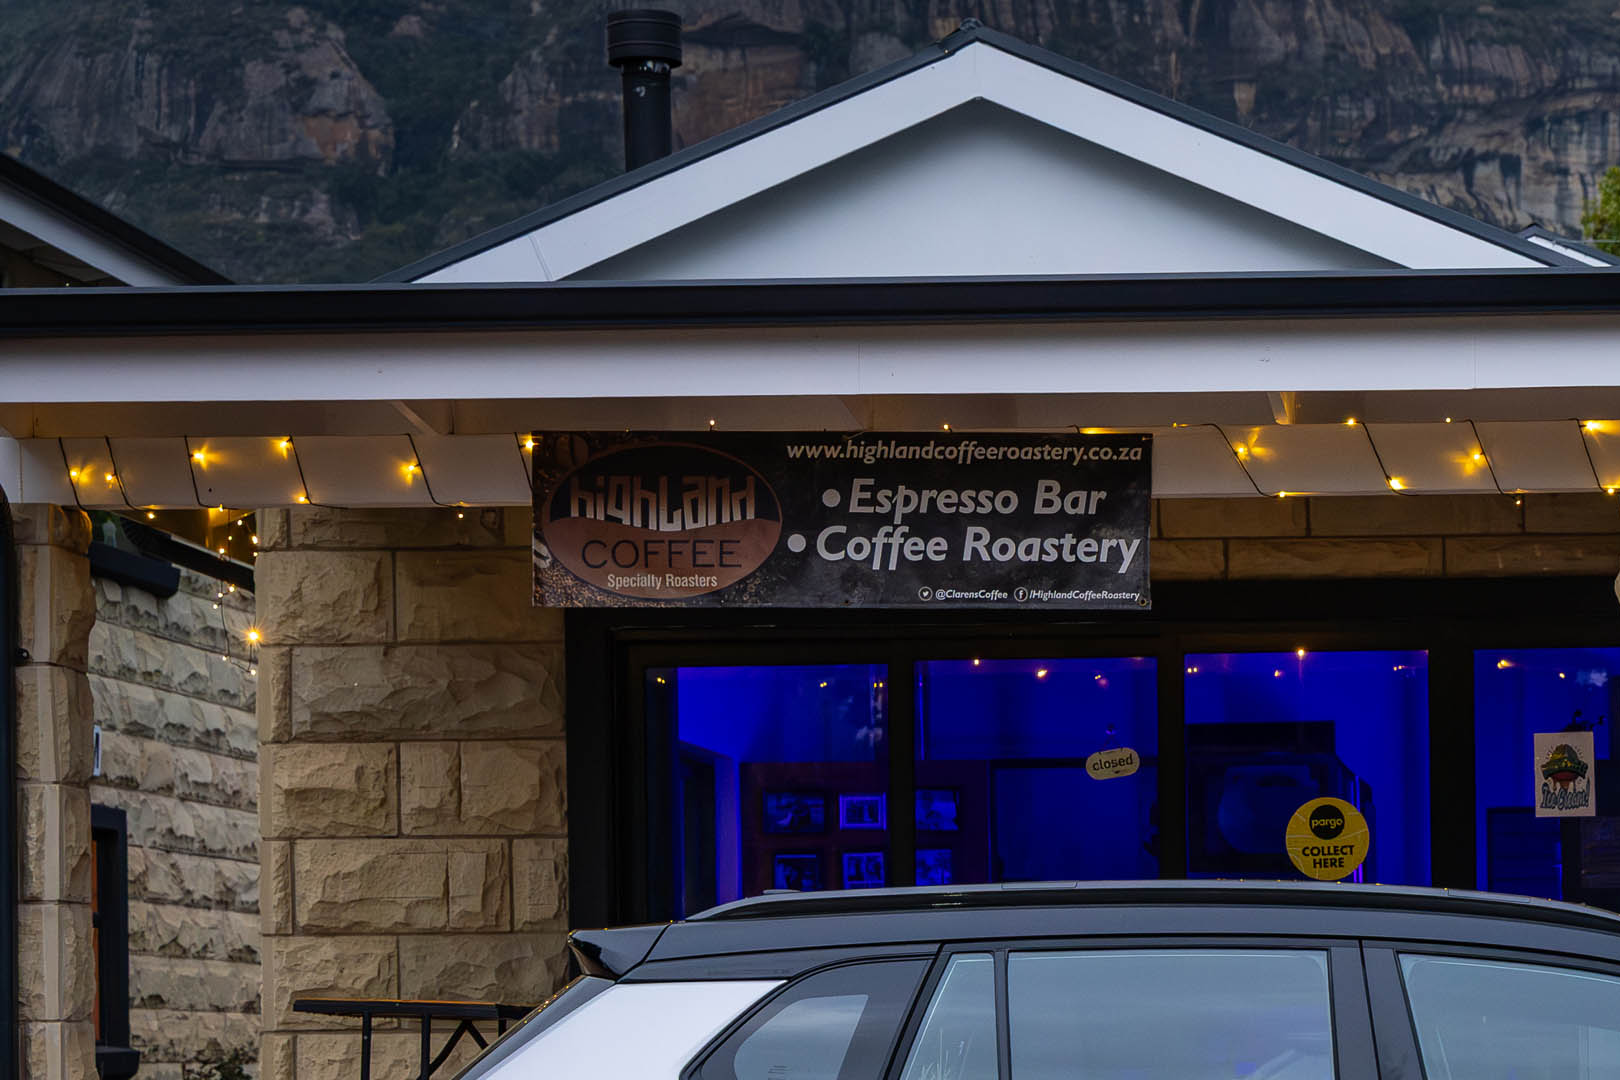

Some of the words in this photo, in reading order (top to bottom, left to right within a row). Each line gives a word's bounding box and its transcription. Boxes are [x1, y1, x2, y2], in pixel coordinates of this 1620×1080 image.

[786, 440, 1143, 466] www.highlandcoffeeroastery.co.za
[849, 478, 1019, 525] Espresso
[1033, 479, 1107, 515] Bar
[581, 539, 742, 569] COFFEE
[816, 525, 949, 571] Coffee
[962, 526, 1141, 574] Roastery
[607, 574, 661, 590] Specialty
[665, 574, 718, 588] Roasters
[935, 589, 1008, 601] @ClarensCoffee
[1029, 590, 1140, 602] /HighlandCoffeeRoastery
[1092, 753, 1133, 771] closed
[1311, 818, 1343, 829] pargo
[1302, 845, 1355, 856] COLLECT
[1312, 857, 1345, 868] HERE
